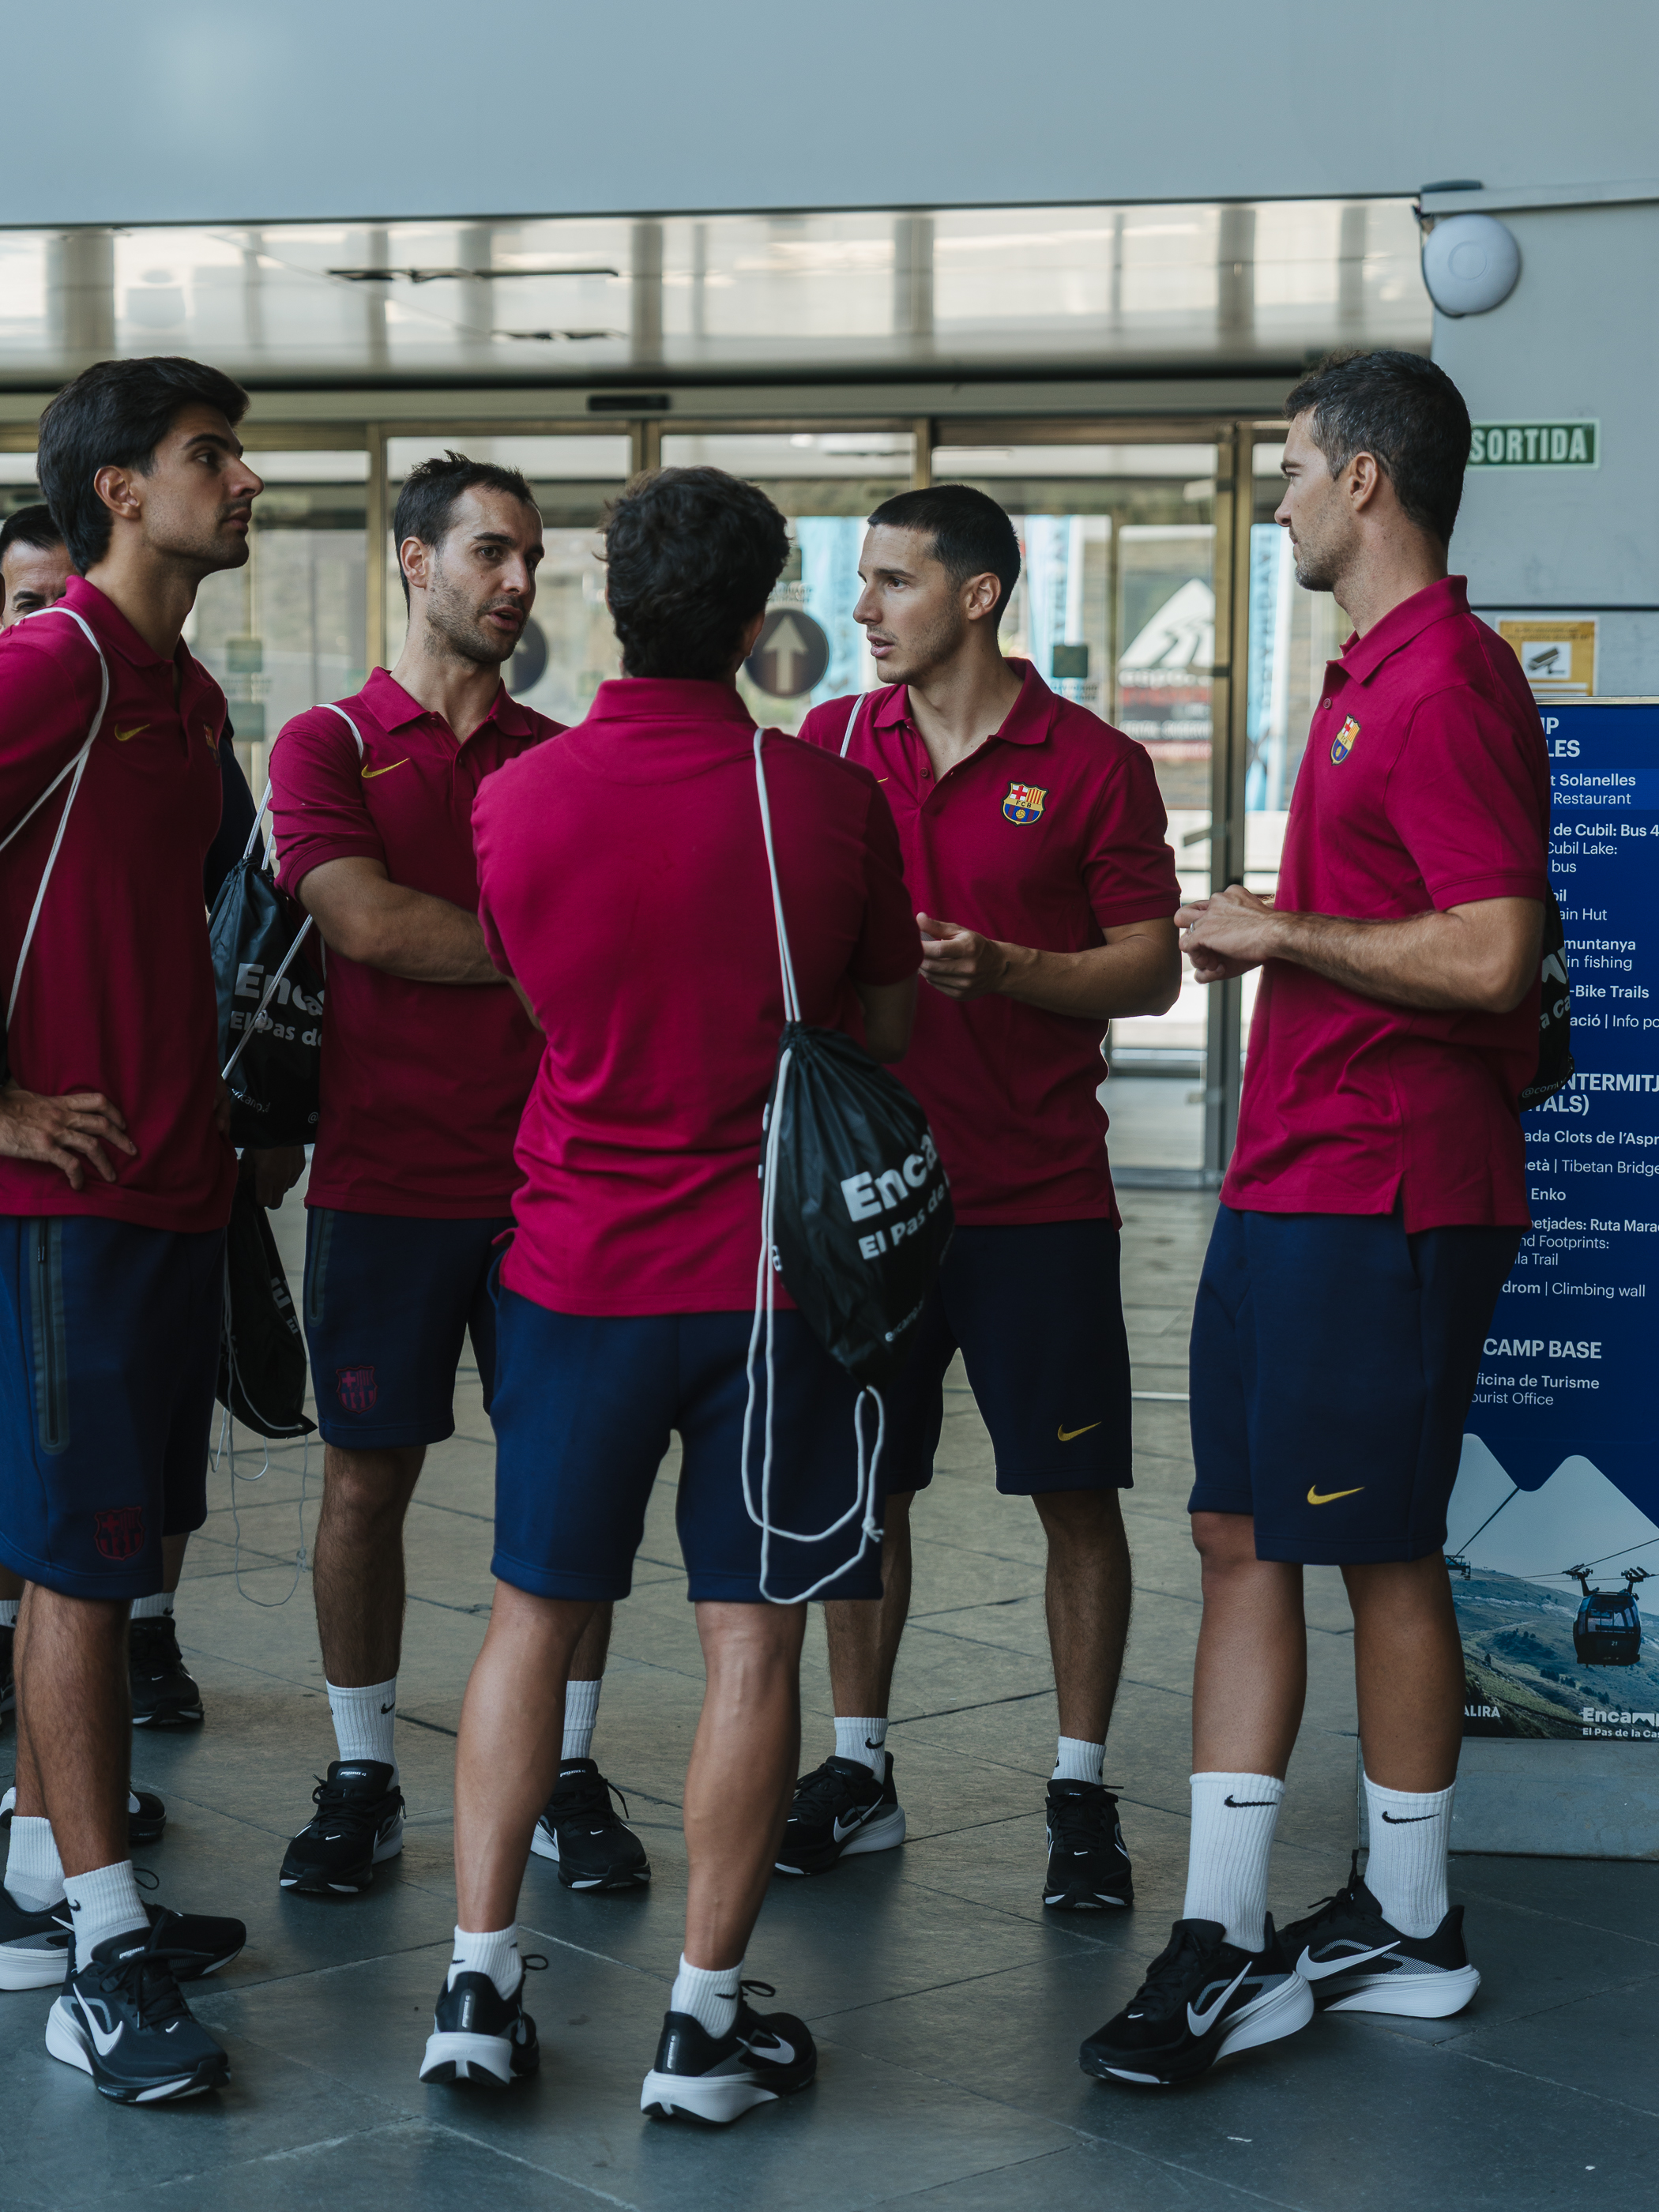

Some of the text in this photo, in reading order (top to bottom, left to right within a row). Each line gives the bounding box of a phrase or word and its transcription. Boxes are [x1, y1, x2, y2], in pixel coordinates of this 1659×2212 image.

[1469, 427, 1588, 463] SORTIDA
[1559, 773, 1636, 786] Solanelles
[1554, 792, 1631, 804] Restaurant
[1553, 823, 1572, 836] de
[1575, 823, 1616, 836] Cubil:
[1621, 825, 1646, 837] Bus
[1548, 841, 1618, 855] Cubil Lake:
[1552, 860, 1577, 872] bus
[1583, 908, 1607, 920] Hut
[1564, 939, 1635, 953] muntanya
[1567, 955, 1632, 971] in fishing
[1610, 986, 1650, 999] Trails
[1570, 1014, 1601, 1027] ació
[1613, 1014, 1638, 1027] Info
[1525, 1130, 1550, 1142] ada
[1555, 1130, 1593, 1143] Clots
[1596, 1131, 1615, 1144] de
[1525, 1159, 1550, 1171] età
[1562, 1160, 1612, 1172] Tibetan
[1618, 1161, 1659, 1176] Bridge
[1531, 1188, 1566, 1201] Enko
[1531, 1217, 1586, 1232] etjades:
[1591, 1219, 1620, 1232] Ruta
[858, 1229, 886, 1260] El
[890, 1208, 926, 1247] Pas
[1540, 1236, 1609, 1250] Footprints:
[1532, 1253, 1559, 1266] Trail
[1552, 1282, 1615, 1299] Climbing
[1619, 1285, 1646, 1297] wall
[1483, 1338, 1602, 1359] CAMP BASE
[1519, 1375, 1537, 1387] de
[1541, 1375, 1600, 1389] Turisme
[1512, 1392, 1553, 1405] Office
[1594, 1728, 1612, 1736] Pas
